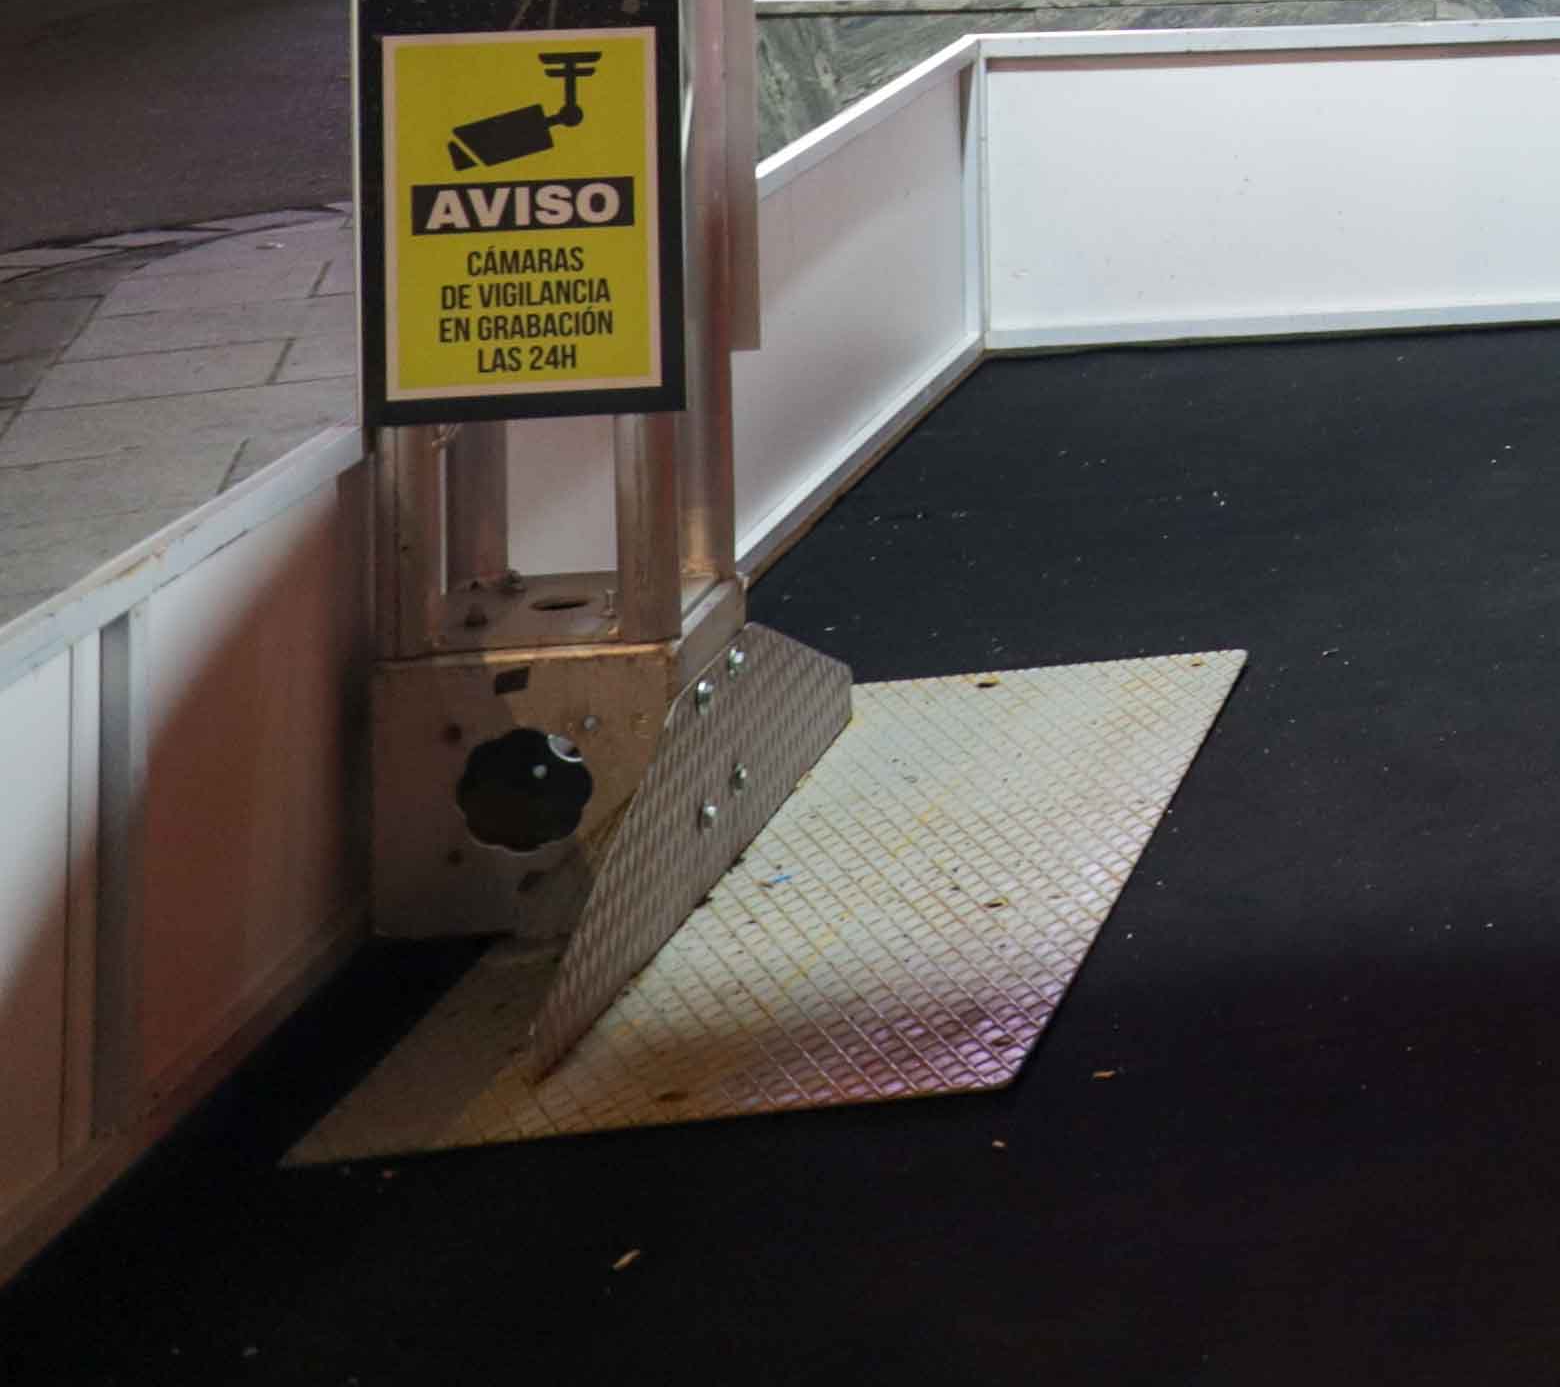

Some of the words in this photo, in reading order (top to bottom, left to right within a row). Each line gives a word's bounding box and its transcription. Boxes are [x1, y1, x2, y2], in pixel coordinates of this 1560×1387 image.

[425, 182, 621, 231] AVISO
[466, 246, 584, 277] CÁMARAS
[441, 284, 472, 311] DE
[477, 277, 612, 309] VIGILANCIA
[439, 317, 471, 344] EN
[477, 306, 614, 341] GRABACIÓN
[477, 347, 523, 374] LAS
[529, 344, 577, 371] 24H
